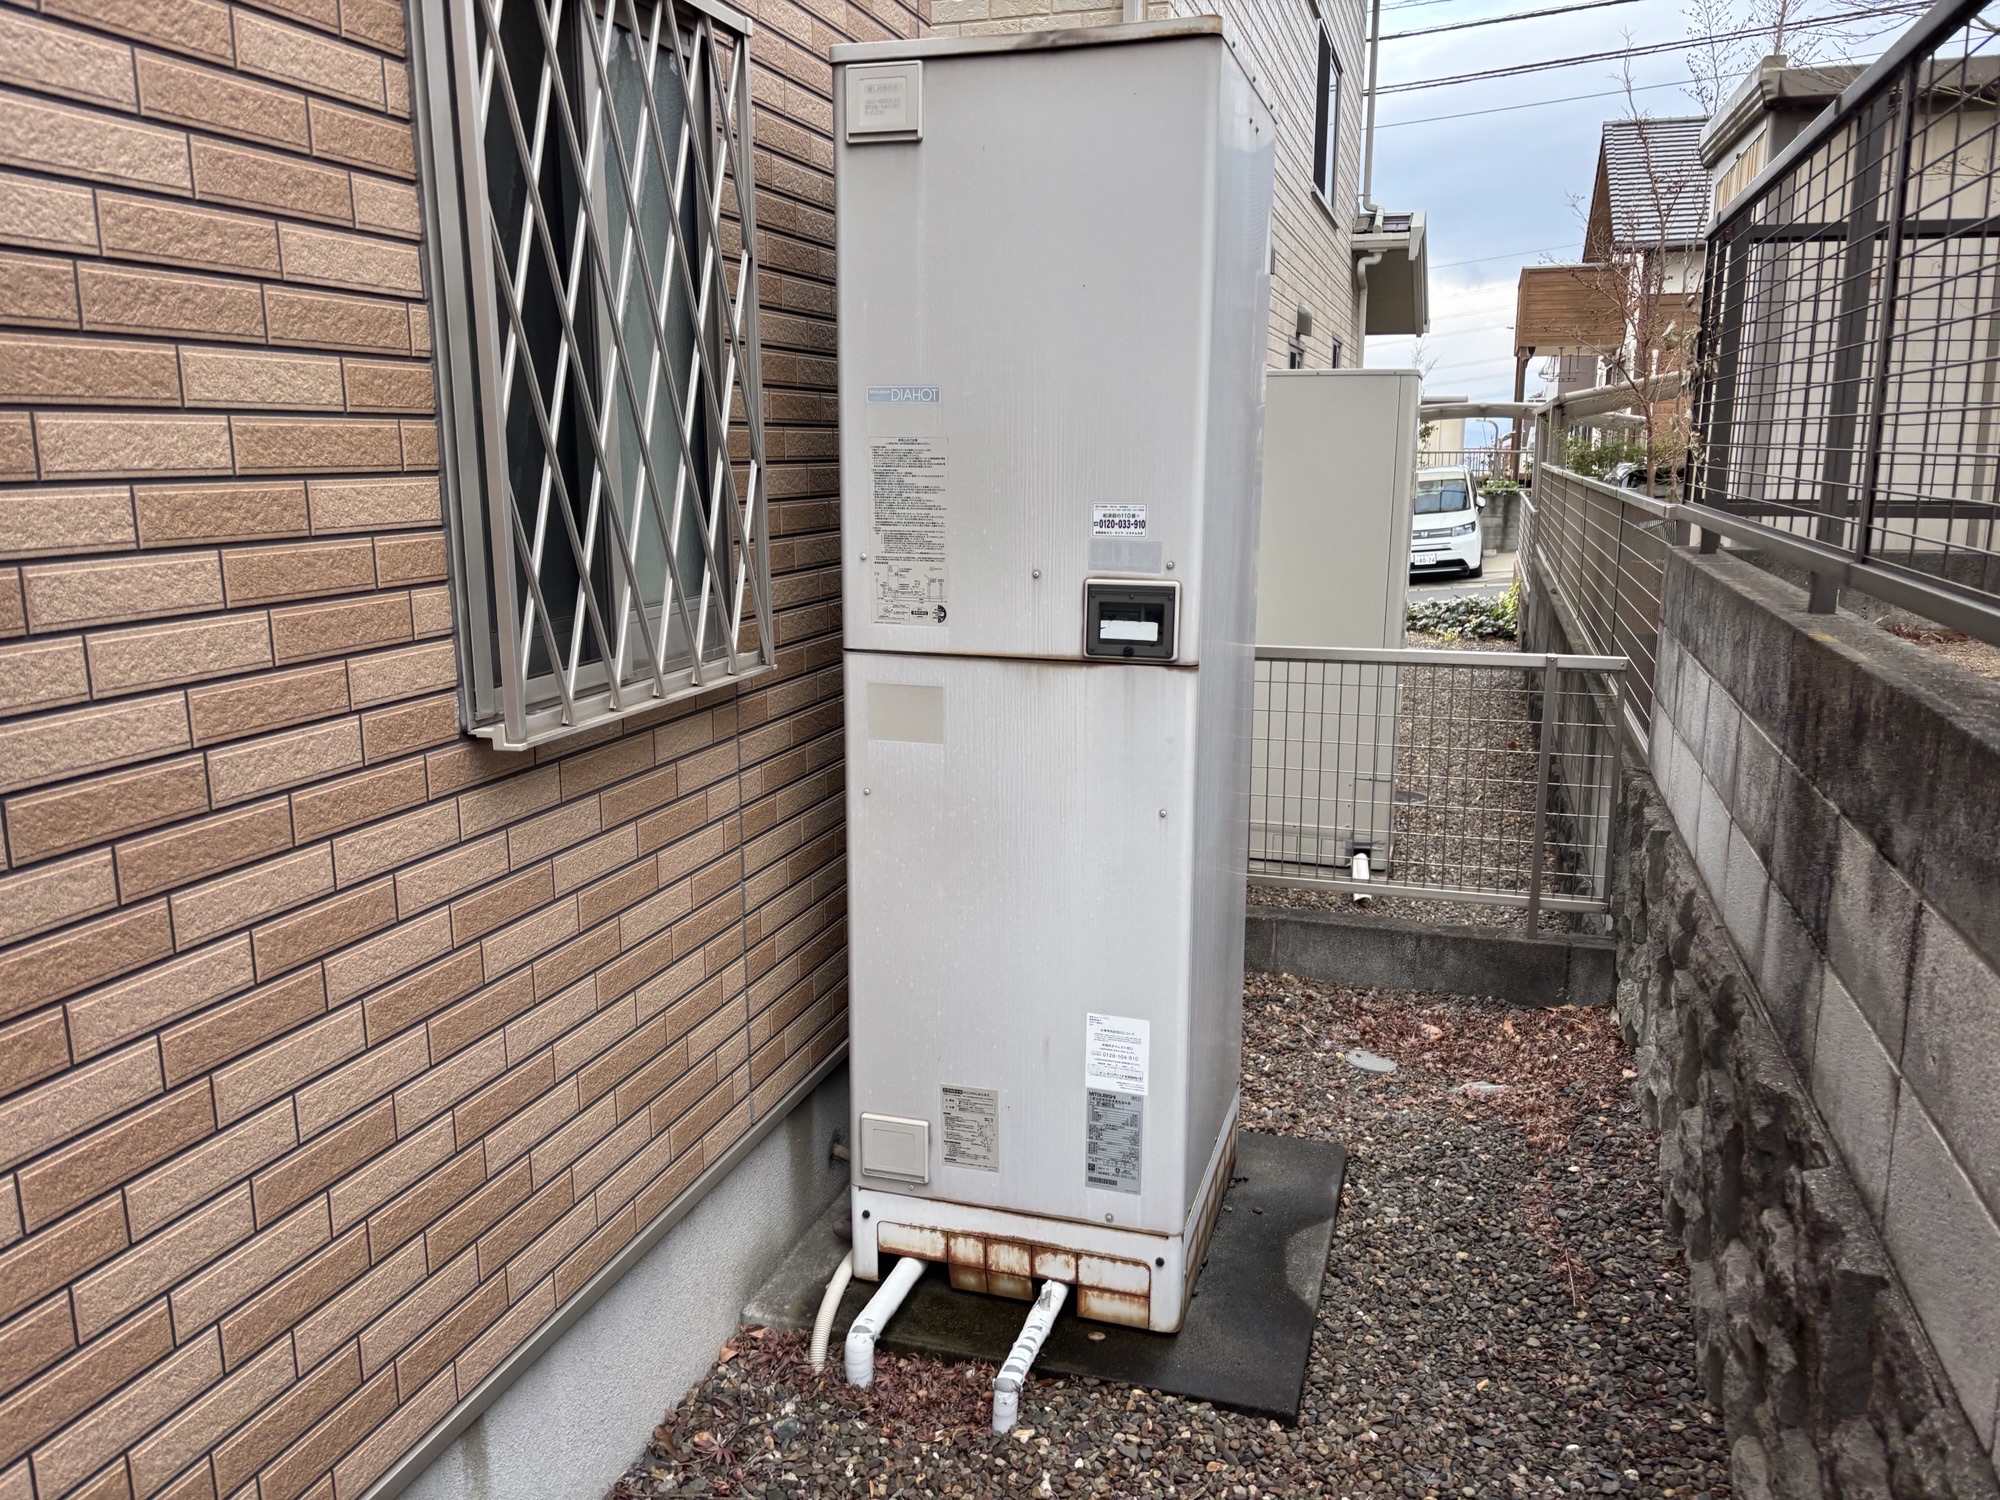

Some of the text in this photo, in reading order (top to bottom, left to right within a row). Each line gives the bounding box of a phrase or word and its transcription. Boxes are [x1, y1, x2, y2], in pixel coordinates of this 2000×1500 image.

[891, 388, 938, 402] DIAHOT
[1099, 519, 1146, 529] 0120-033-910
[1089, 1091, 1116, 1099] MITSUBISHI
